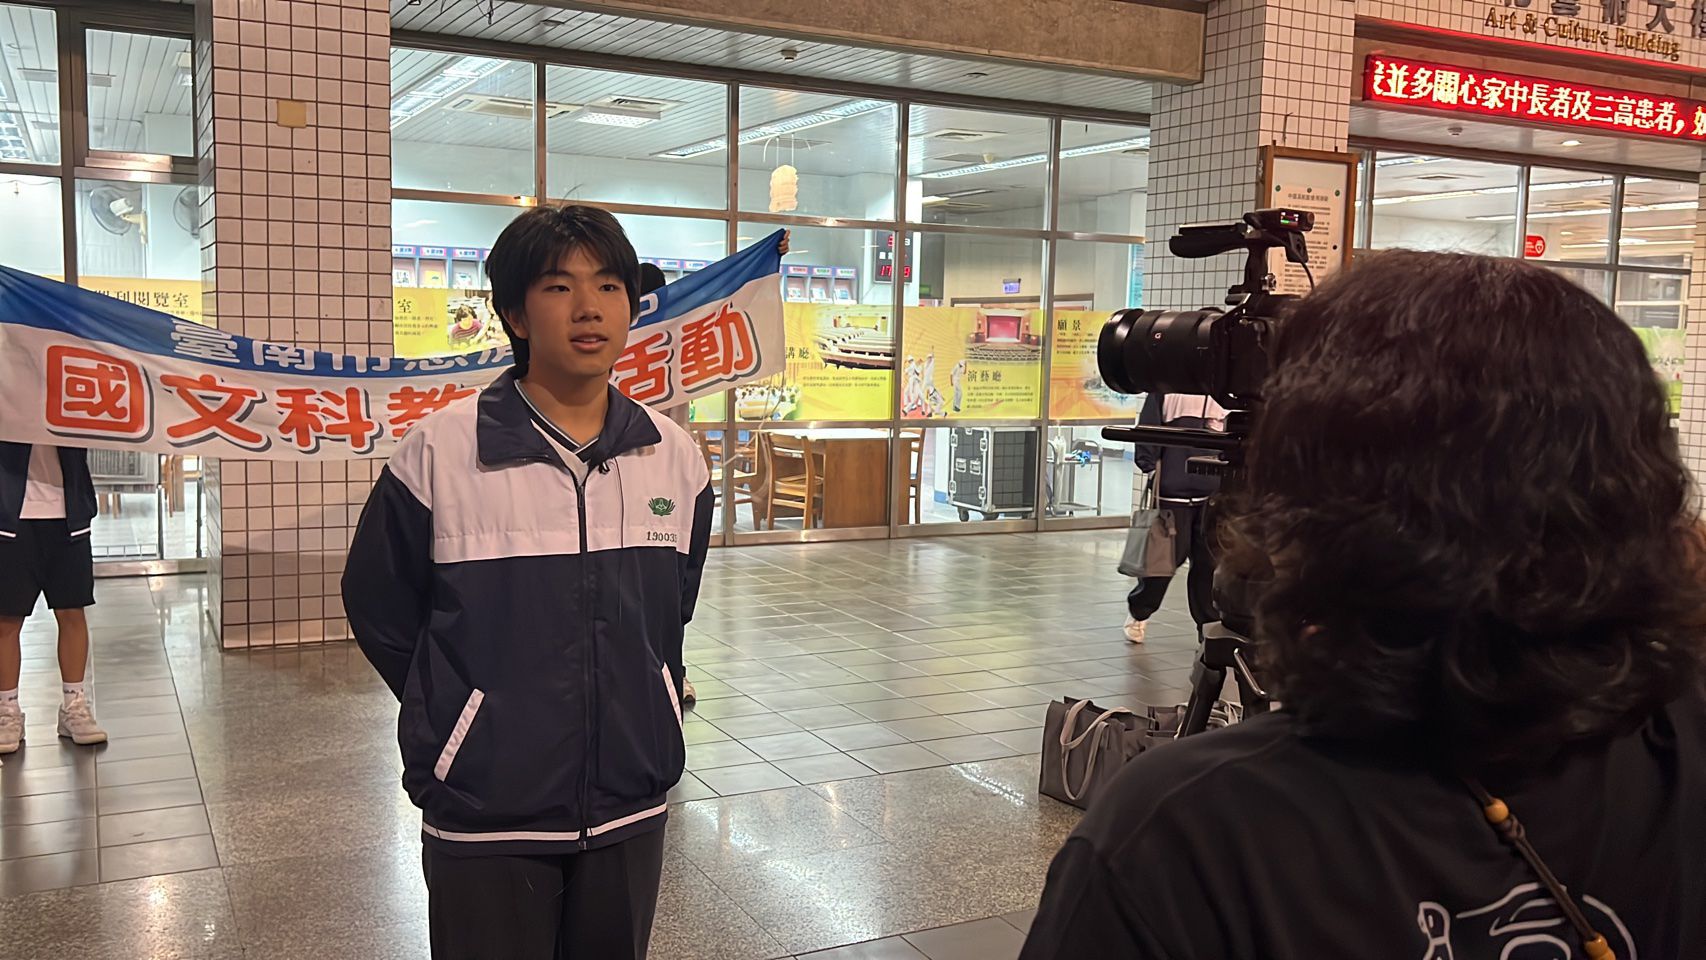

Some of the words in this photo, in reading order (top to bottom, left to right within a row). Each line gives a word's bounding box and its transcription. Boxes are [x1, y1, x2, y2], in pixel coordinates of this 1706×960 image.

[1484, 7, 1517, 30] Art
[1522, 13, 1538, 34] &
[1543, 16, 1609, 45] Culture
[1614, 27, 1681, 61] Building
[1057, 319, 1081, 331] 願景
[967, 369, 1002, 382] 演藝廳
